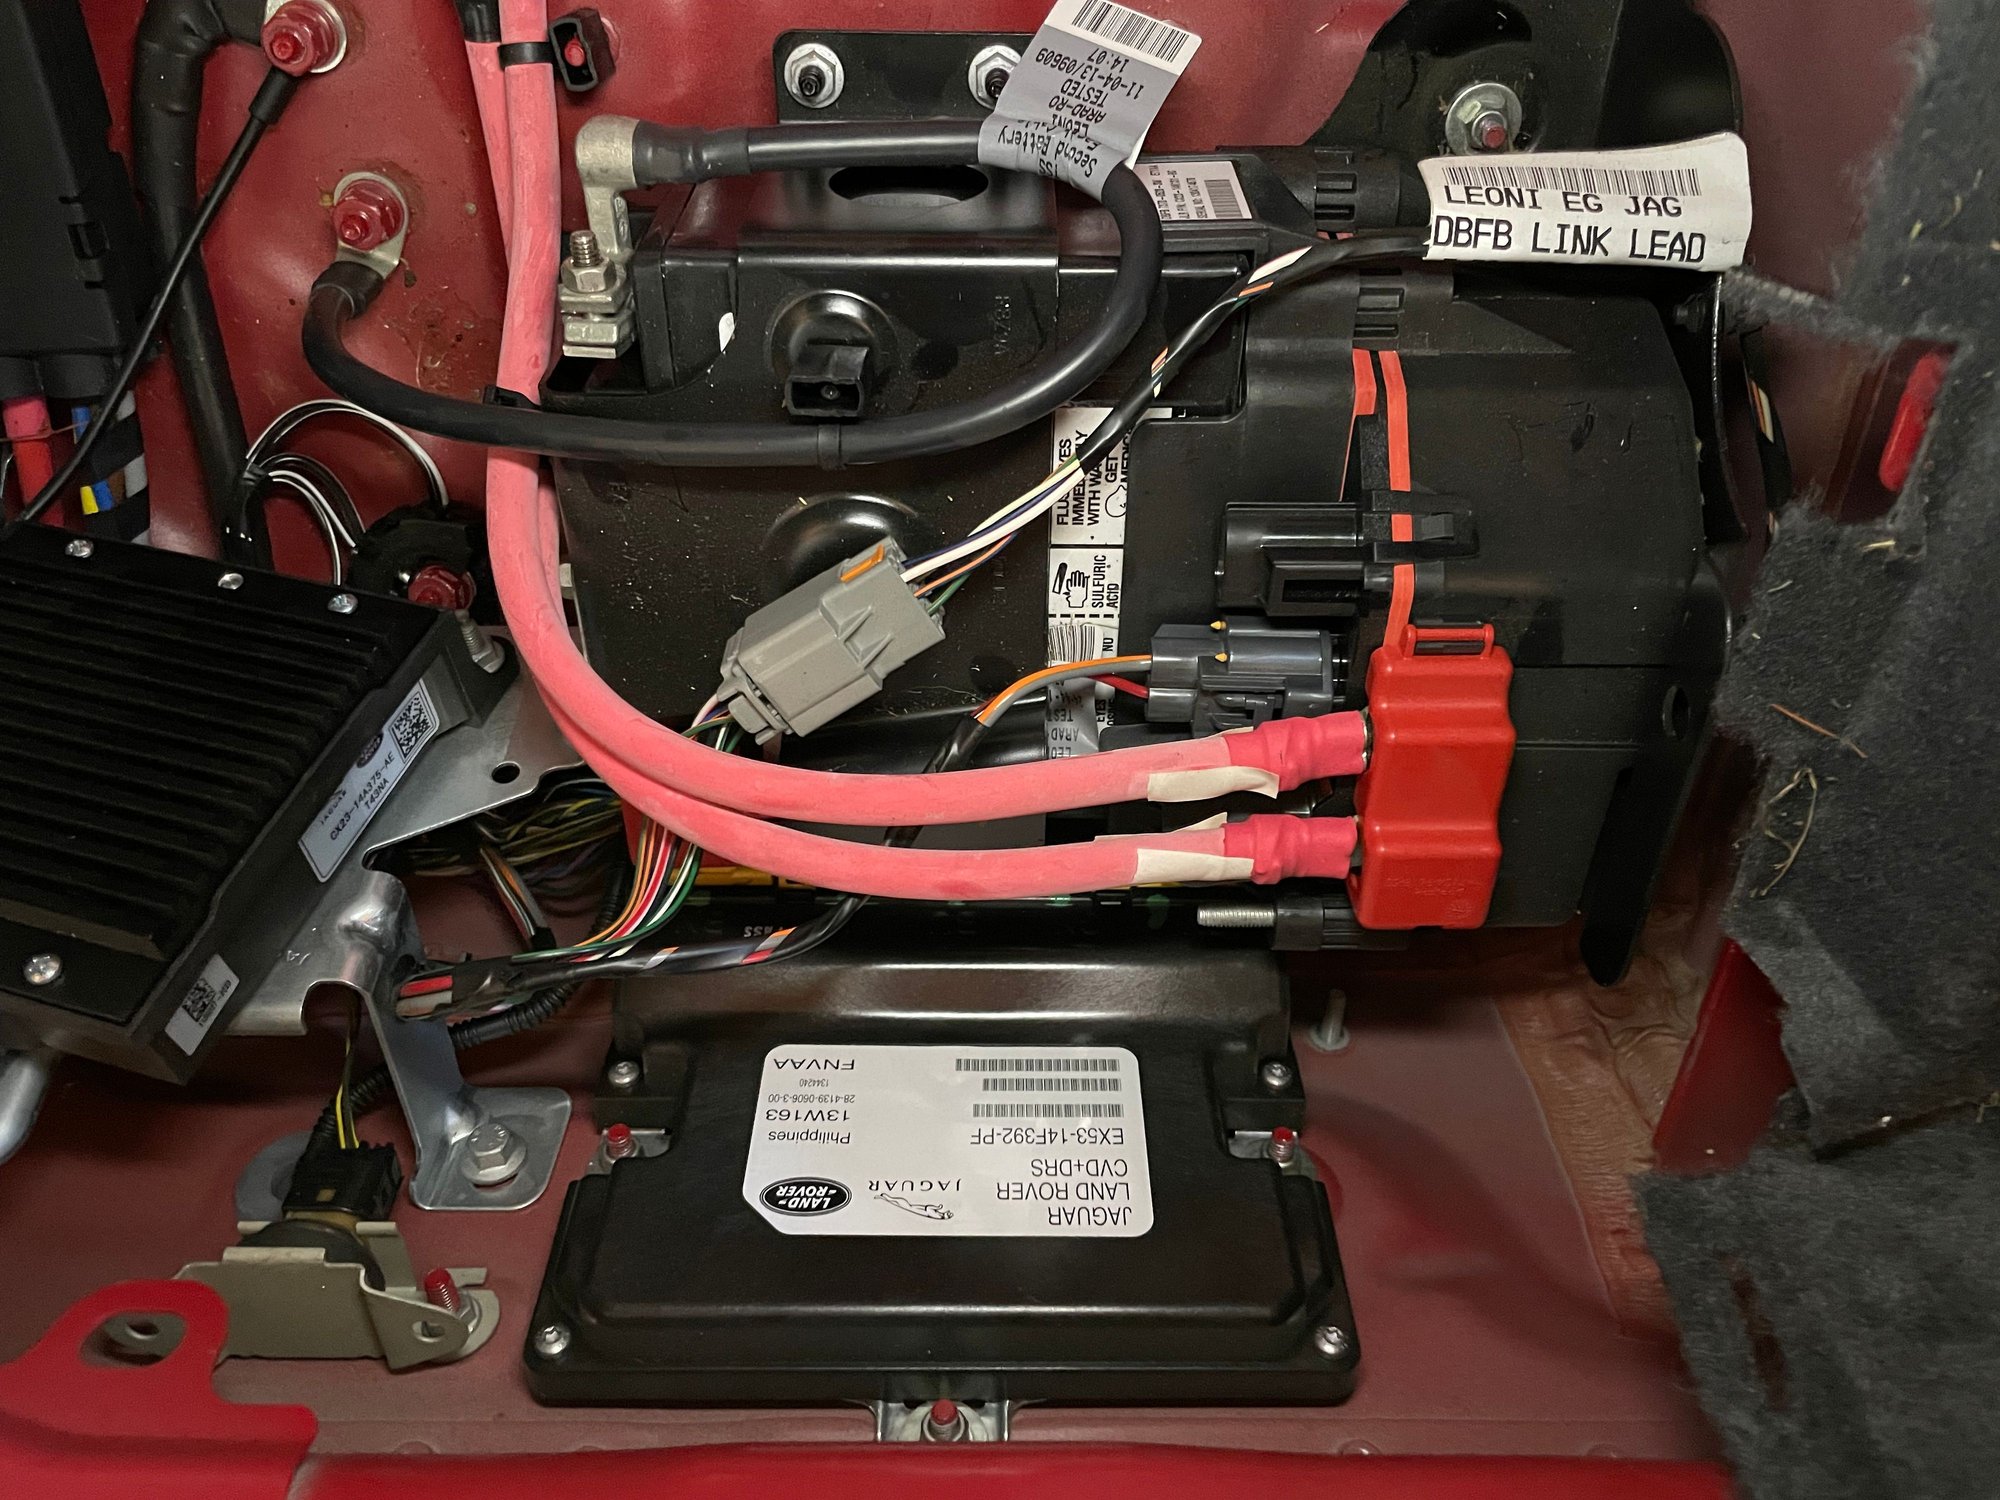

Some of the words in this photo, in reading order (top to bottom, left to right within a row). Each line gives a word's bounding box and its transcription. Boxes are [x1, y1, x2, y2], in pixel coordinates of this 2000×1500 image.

[1087, 48, 1129, 73] 14:07
[1035, 47, 1144, 100] 11-04-13/09609
[1060, 78, 1109, 108] TESTED
[1048, 95, 1107, 124] ARAD-RO
[998, 125, 1052, 156] Battery
[1054, 140, 1098, 178] Second
[1444, 185, 1542, 209] LEONI
[1562, 191, 1603, 213] EG
[1624, 196, 1682, 218] JAG
[1433, 215, 1513, 250] DBFB
[1531, 222, 1612, 257] LINK
[1629, 228, 1707, 263] LEAD
[1105, 455, 1118, 483] GET
[1056, 492, 1070, 526] FLUS
[1088, 490, 1101, 526] WITH
[1092, 555, 1106, 608] SULFURIC
[1106, 583, 1119, 609] ACID
[1102, 637, 1114, 652] NO
[330, 751, 395, 840] CX23-14A375-AE
[364, 778, 389, 810] T43NA
[773, 1058, 855, 1070] FNVAA
[799, 1078, 829, 1088] 1344240
[768, 1094, 856, 1103] 28-4139-0606-3-00
[766, 1109, 850, 1121] 13W163
[768, 1131, 850, 1144] Philippines
[970, 1127, 1124, 1145] EX53-14F392-PF
[1031, 1158, 1128, 1177] CVD+DRS
[776, 1185, 829, 1197] ROVER
[868, 1179, 961, 1192] JAGUAR
[996, 1182, 1069, 1200] ROVER
[1076, 1182, 1130, 1200] LAND
[787, 1197, 831, 1209] LAND
[1048, 1206, 1132, 1226] JAGUAR
